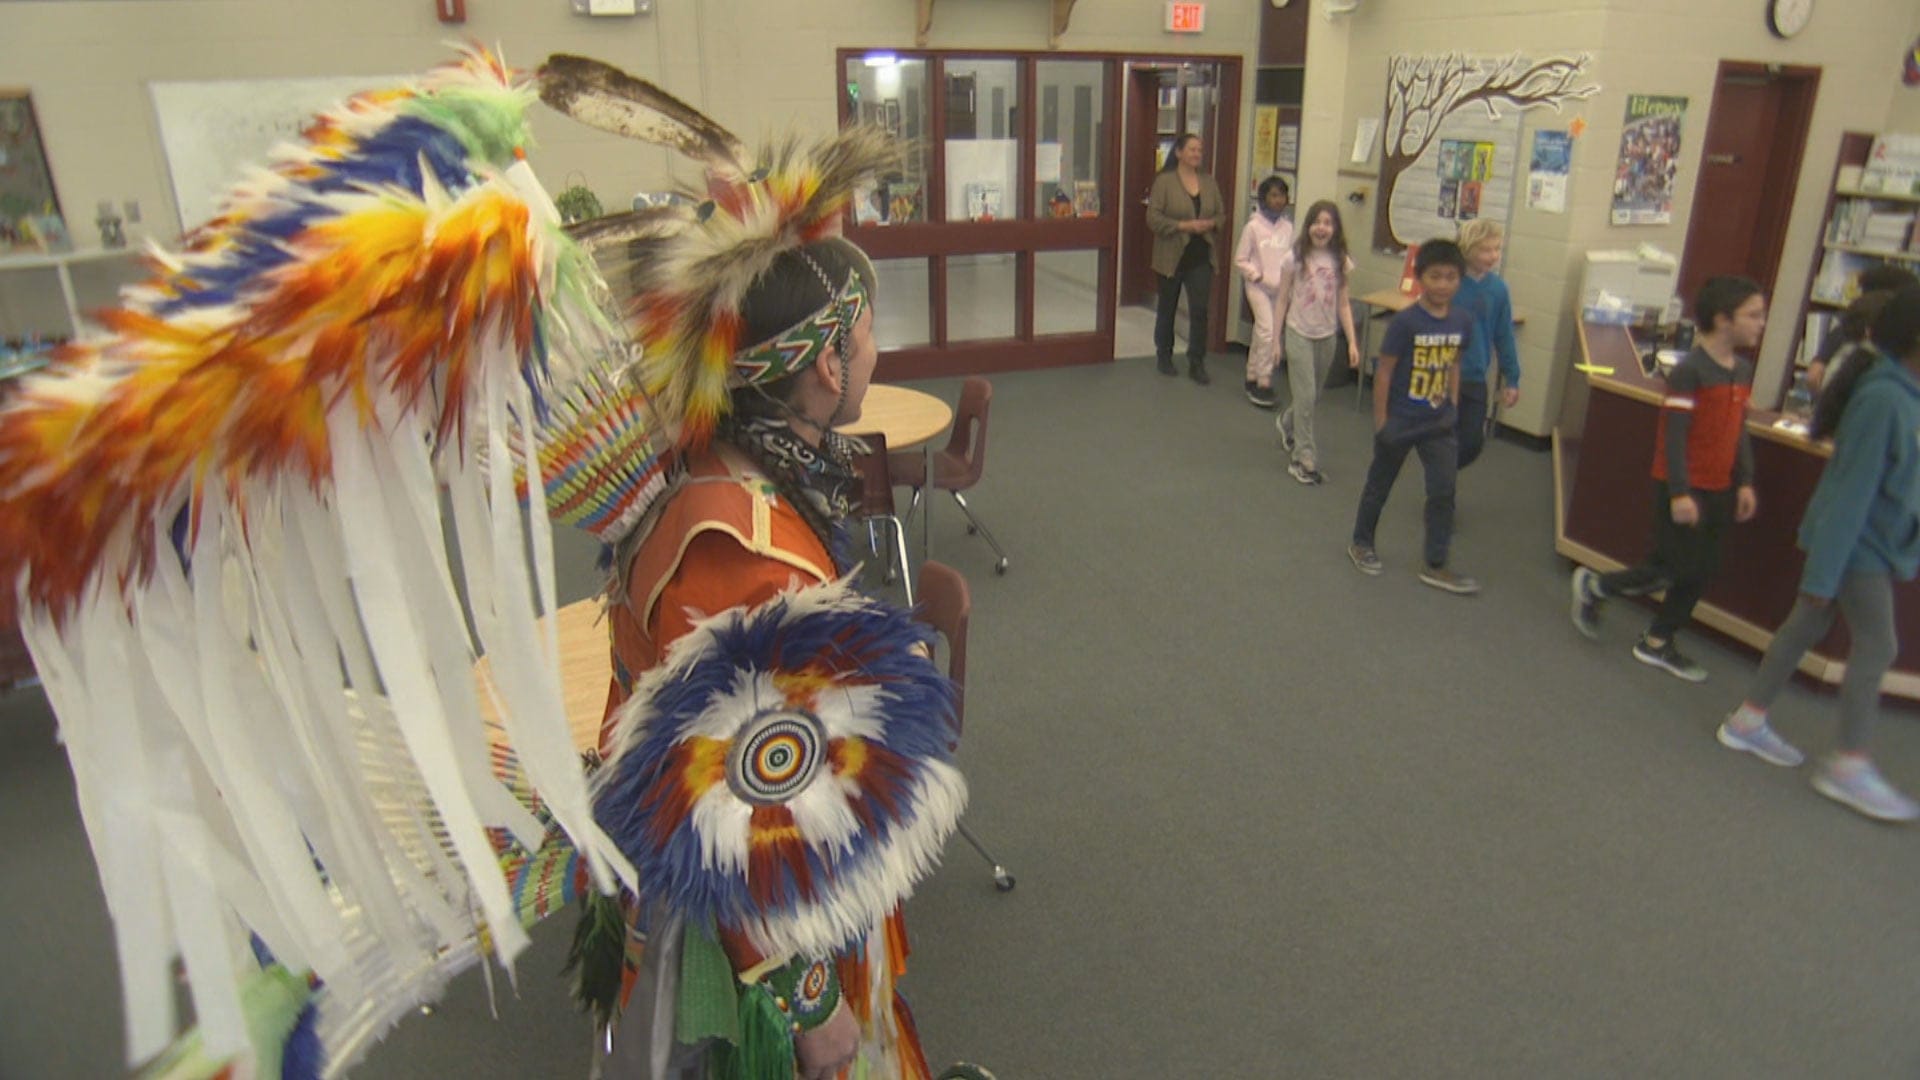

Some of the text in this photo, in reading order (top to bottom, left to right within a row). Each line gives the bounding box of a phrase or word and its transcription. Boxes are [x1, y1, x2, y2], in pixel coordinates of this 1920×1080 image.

[1173, 5, 1200, 28] EXIT
[1413, 347, 1458, 368] GAM
[1408, 370, 1446, 405] DA
